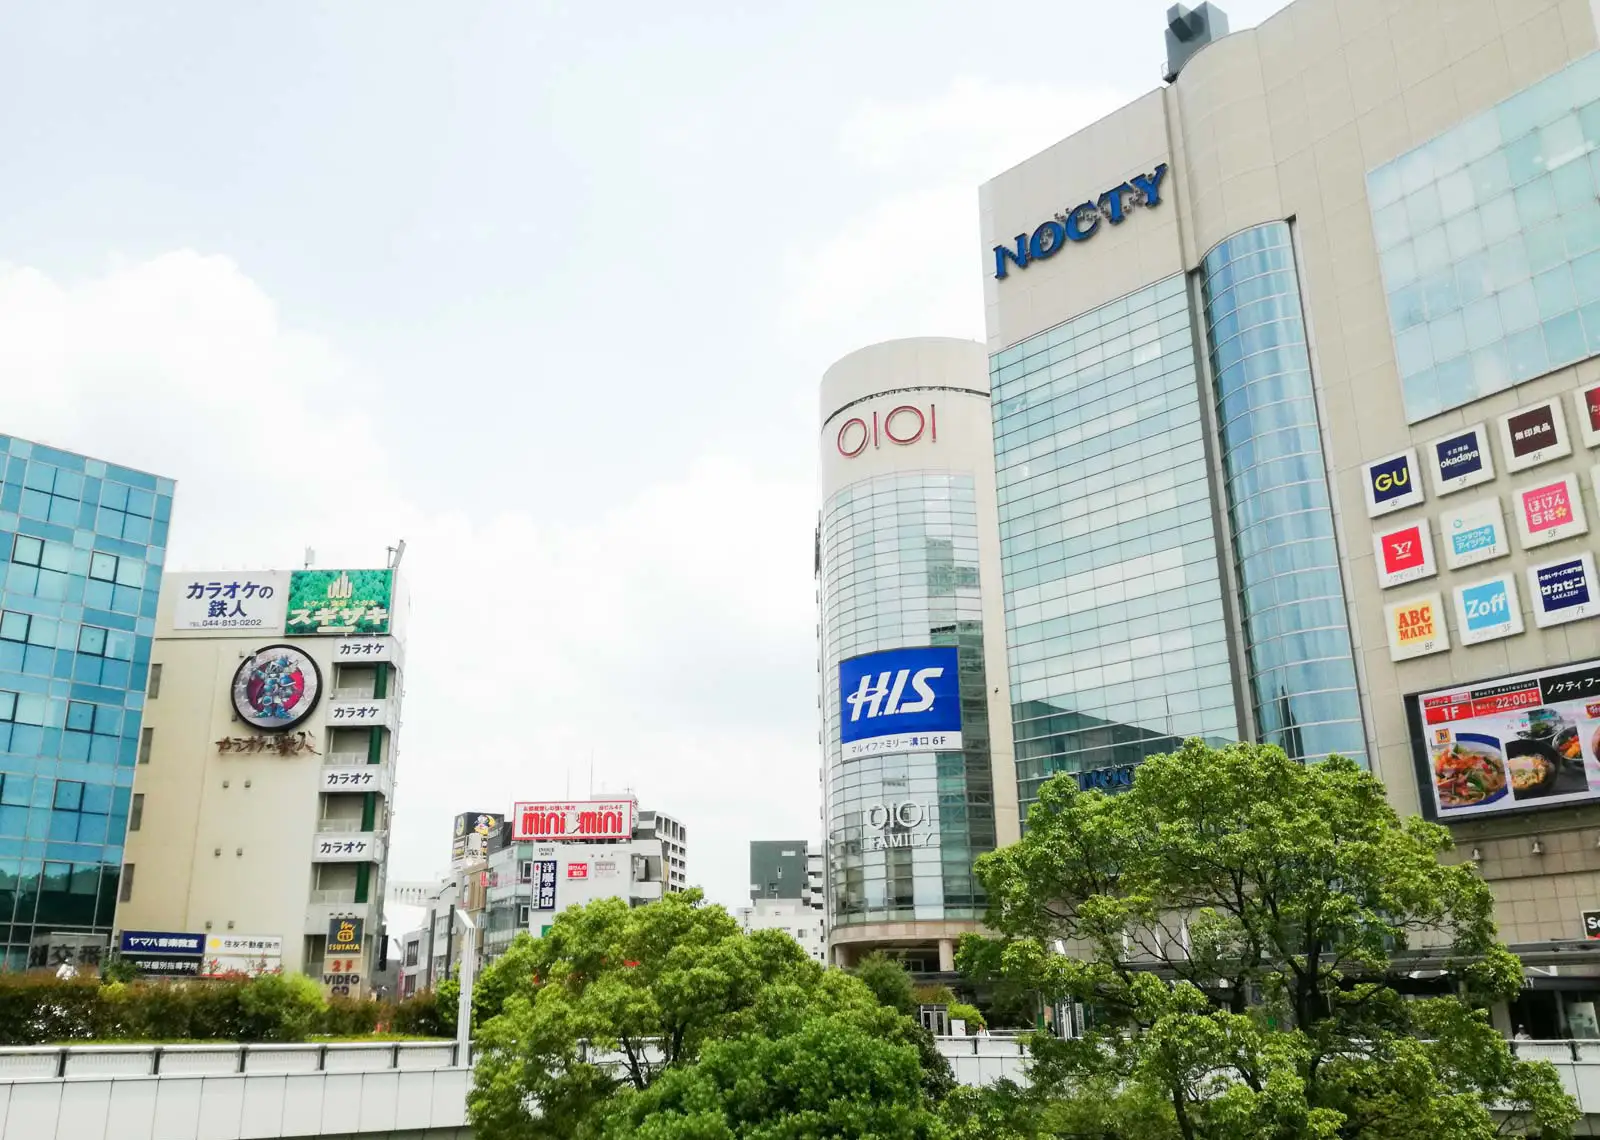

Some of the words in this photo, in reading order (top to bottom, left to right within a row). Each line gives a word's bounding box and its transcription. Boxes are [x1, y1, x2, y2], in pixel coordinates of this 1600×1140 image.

[993, 162, 1168, 279] NOCTY
[1515, 422, 1551, 441] 無印良品
[1440, 450, 1479, 469] okadaya
[1375, 467, 1409, 492] GU
[1528, 493, 1565, 512] ほけん
[186, 582, 274, 599] カラオケの
[1541, 576, 1585, 596] サカゼン
[207, 600, 247, 617] 鉄人
[1466, 592, 1505, 619] Zoff
[1398, 606, 1431, 629] ABC
[1399, 623, 1433, 641] MART
[340, 643, 385, 655] カラオケ
[1496, 693, 1527, 709] 22:00
[334, 707, 379, 719] カラオケ
[1442, 706, 1460, 720] 1F
[932, 736, 947, 746] 6F
[328, 773, 373, 785] カラオケ
[522, 812, 566, 834] mini
[580, 811, 622, 833] mini
[320, 841, 366, 853] カラオケ
[869, 832, 932, 849] FAMILY
[541, 862, 554, 907] 洋服の青山
[1587, 917, 1600, 929] S
[129, 937, 198, 948] ヤマハ音楽教室
[328, 943, 360, 951] TSUTAYA
[323, 974, 360, 985] VIDEO
